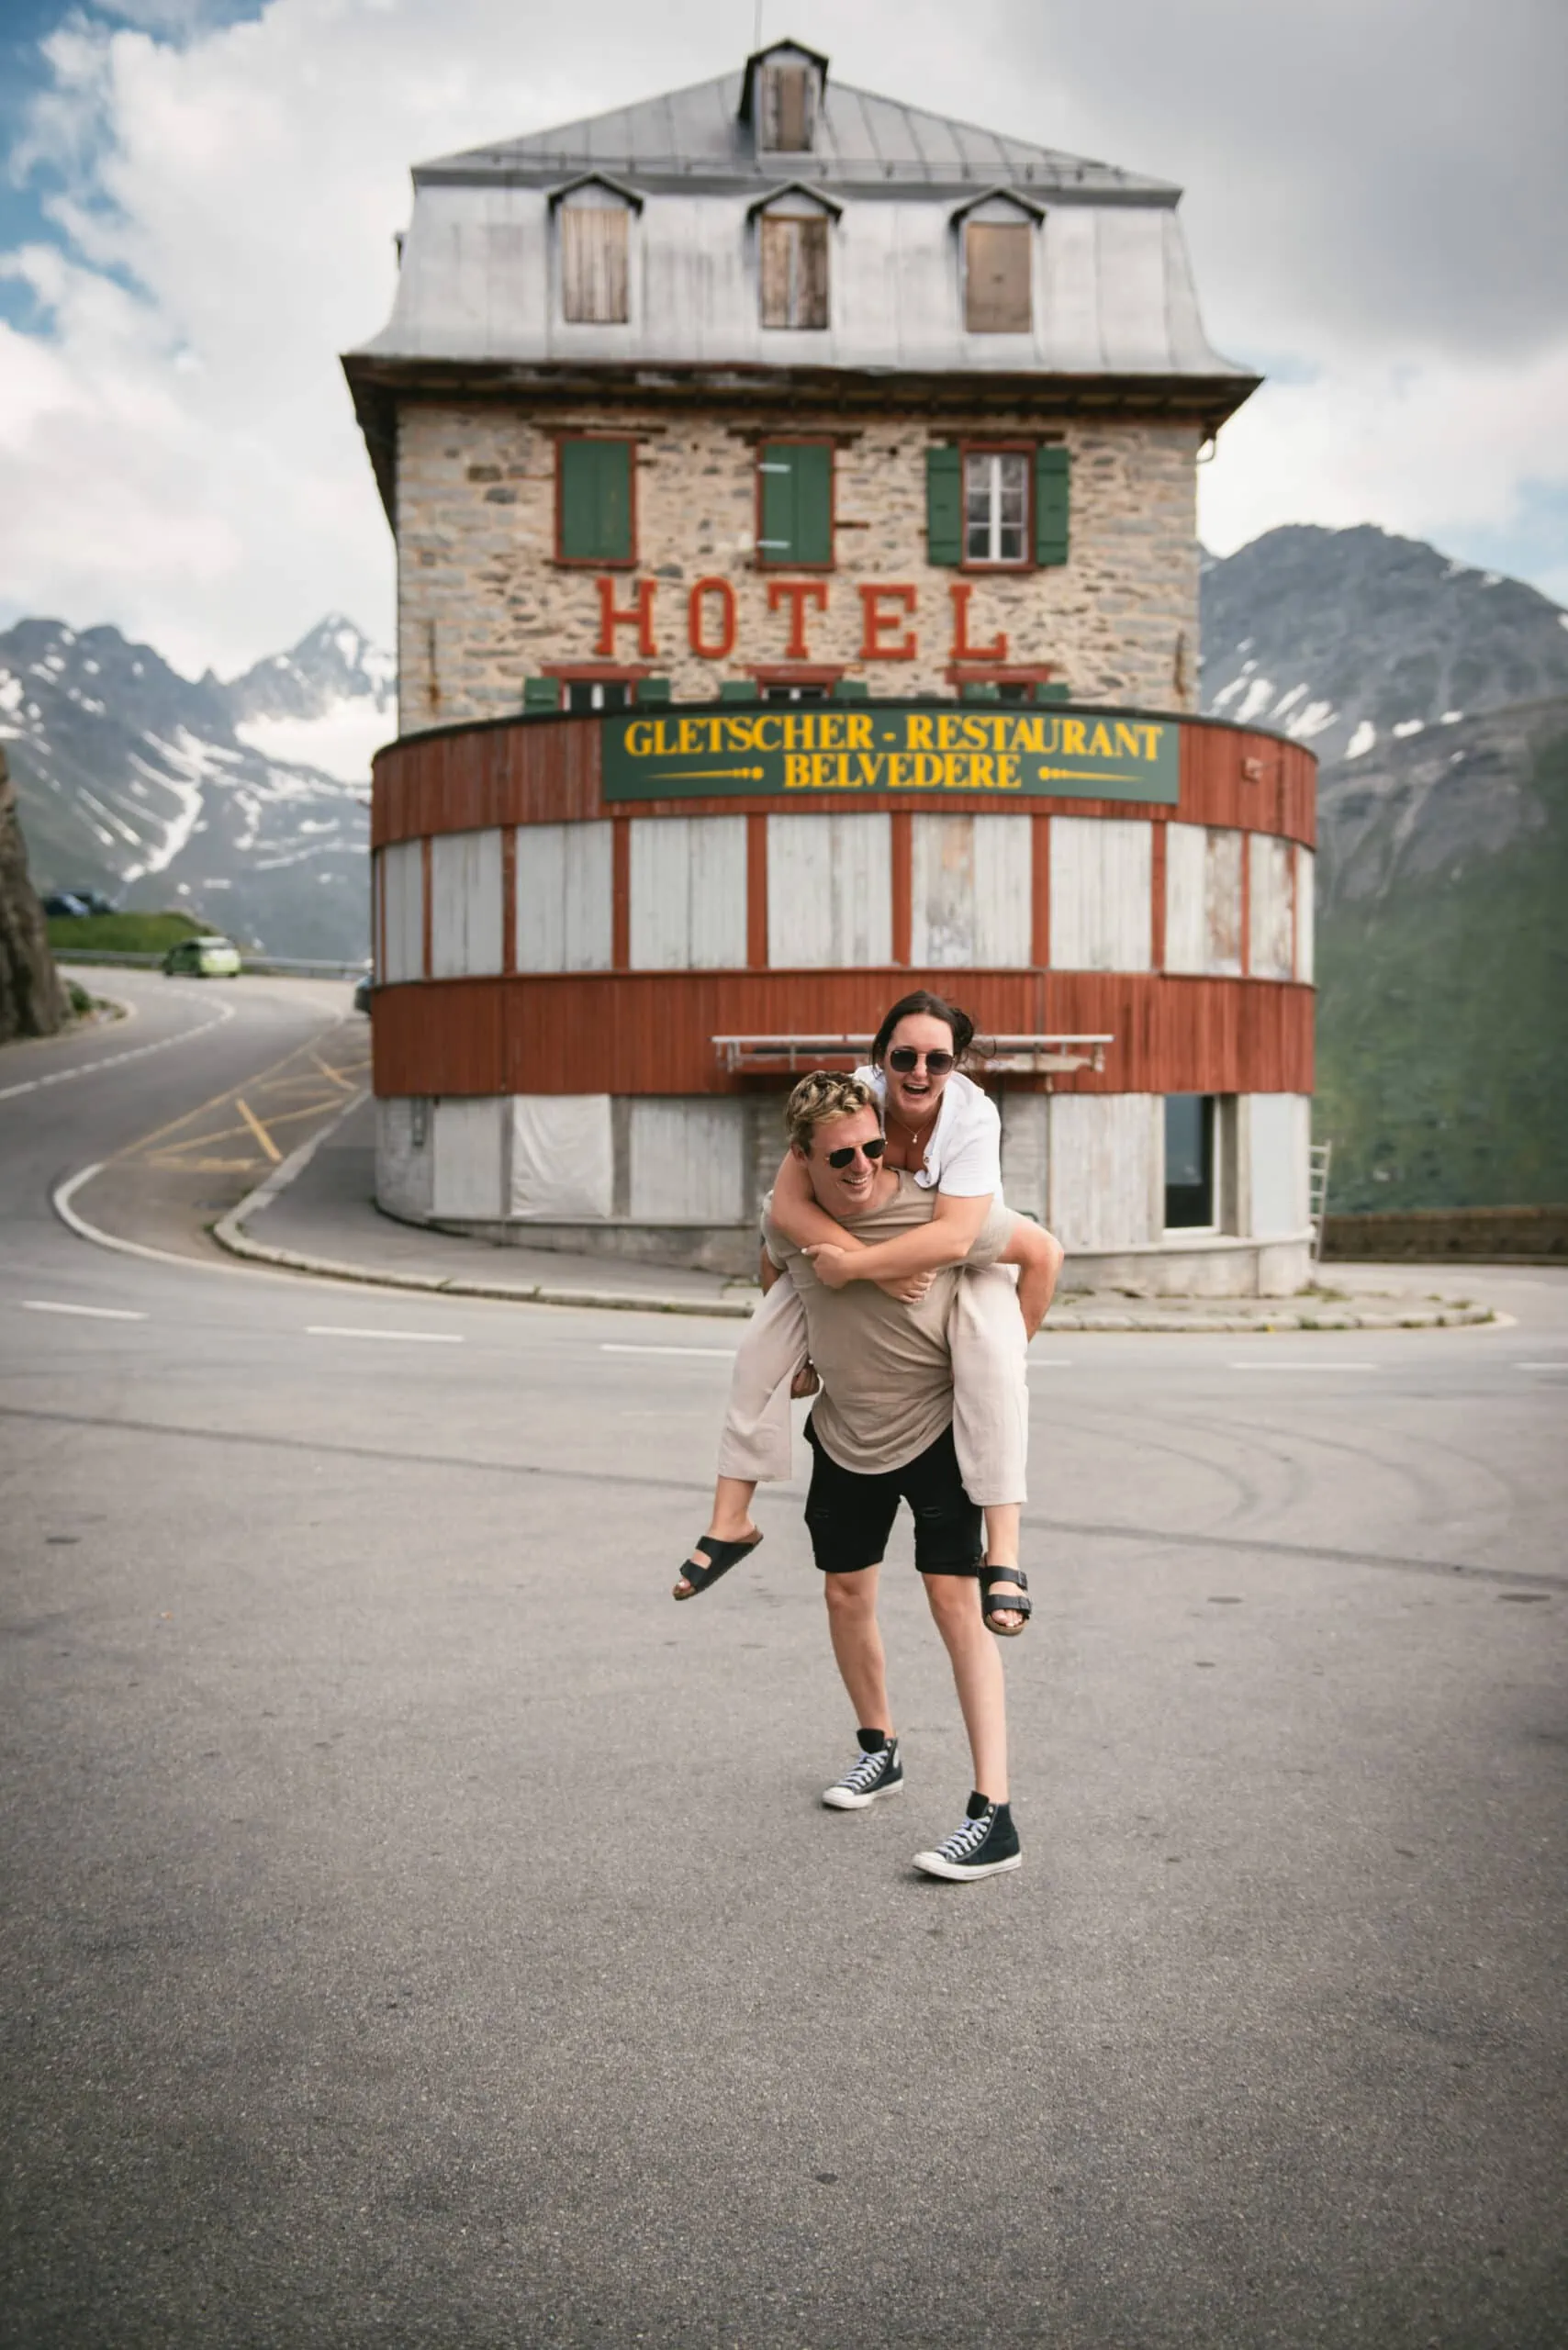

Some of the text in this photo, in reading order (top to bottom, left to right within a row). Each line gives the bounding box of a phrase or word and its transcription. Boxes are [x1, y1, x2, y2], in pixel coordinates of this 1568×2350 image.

[595, 576, 1008, 660] HOTEL
[623, 712, 875, 756] GLETSCHER
[906, 713, 1163, 761] RESTAURANT
[783, 751, 1023, 789] BELVEDERE
